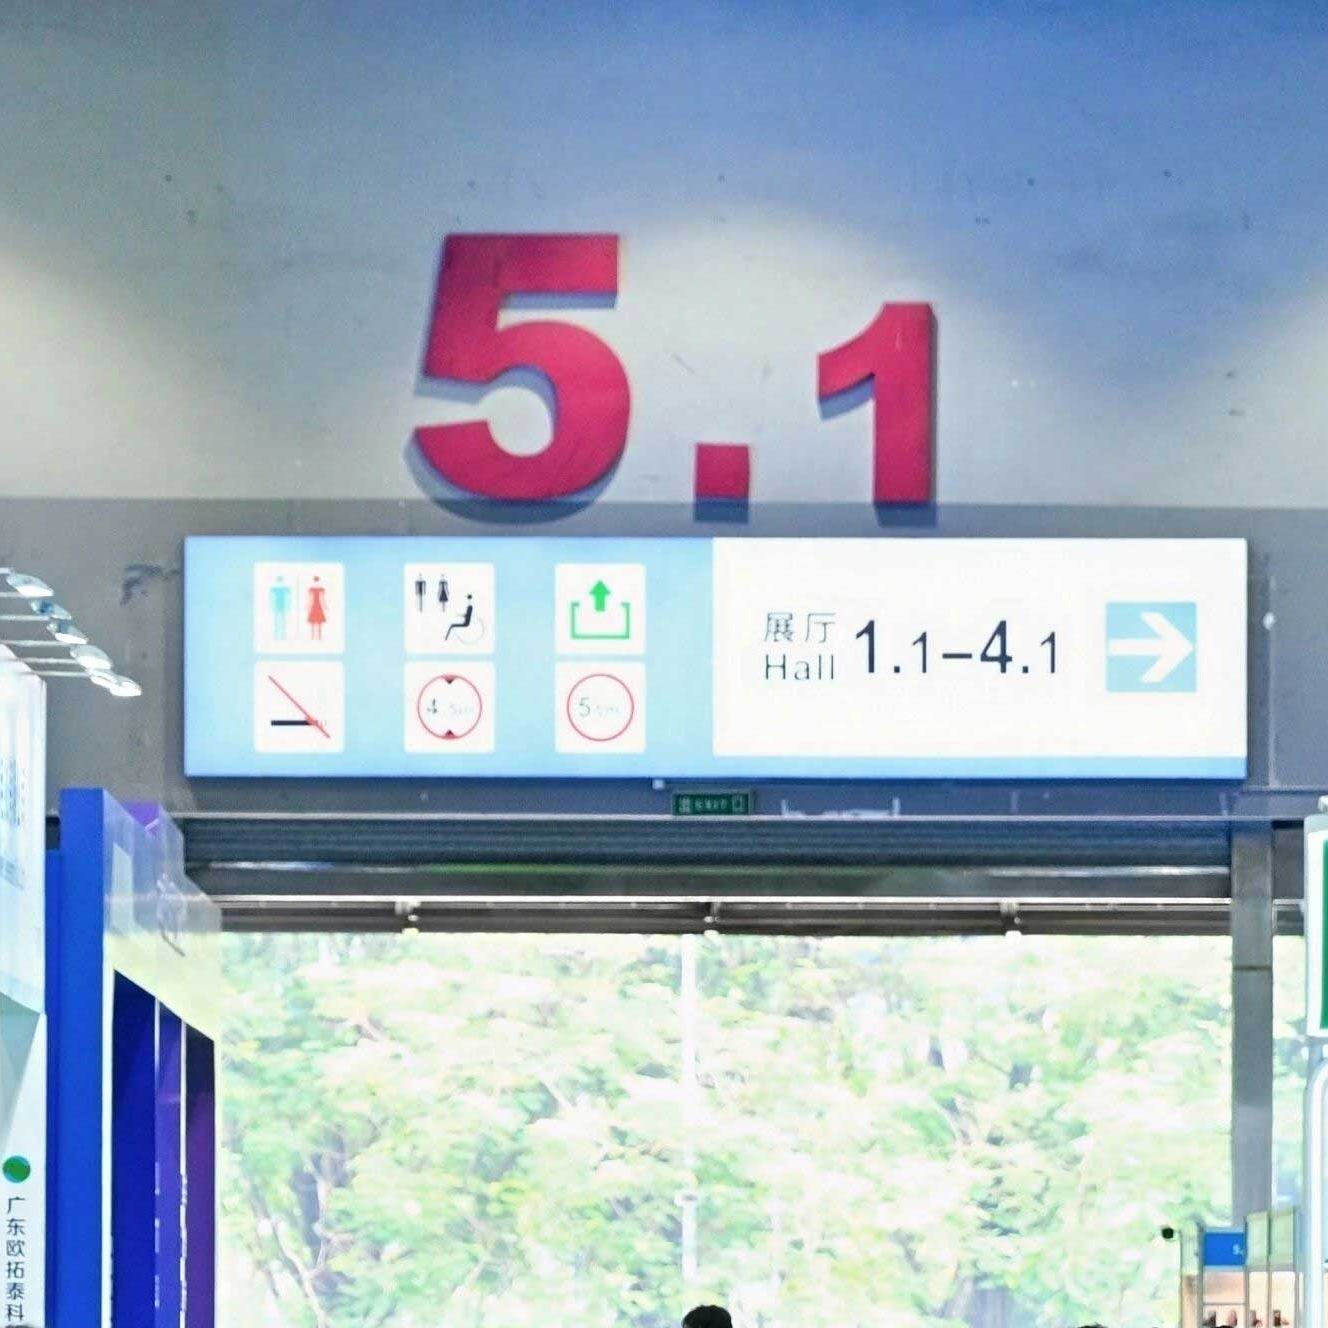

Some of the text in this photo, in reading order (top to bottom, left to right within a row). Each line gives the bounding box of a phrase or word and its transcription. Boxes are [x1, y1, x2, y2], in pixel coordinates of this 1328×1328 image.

[414, 233, 937, 505] 5.1
[765, 612, 836, 642] 展厅
[765, 653, 835, 680] Hall
[6, 1196, 26, 1322] 广东欧拓泰科
